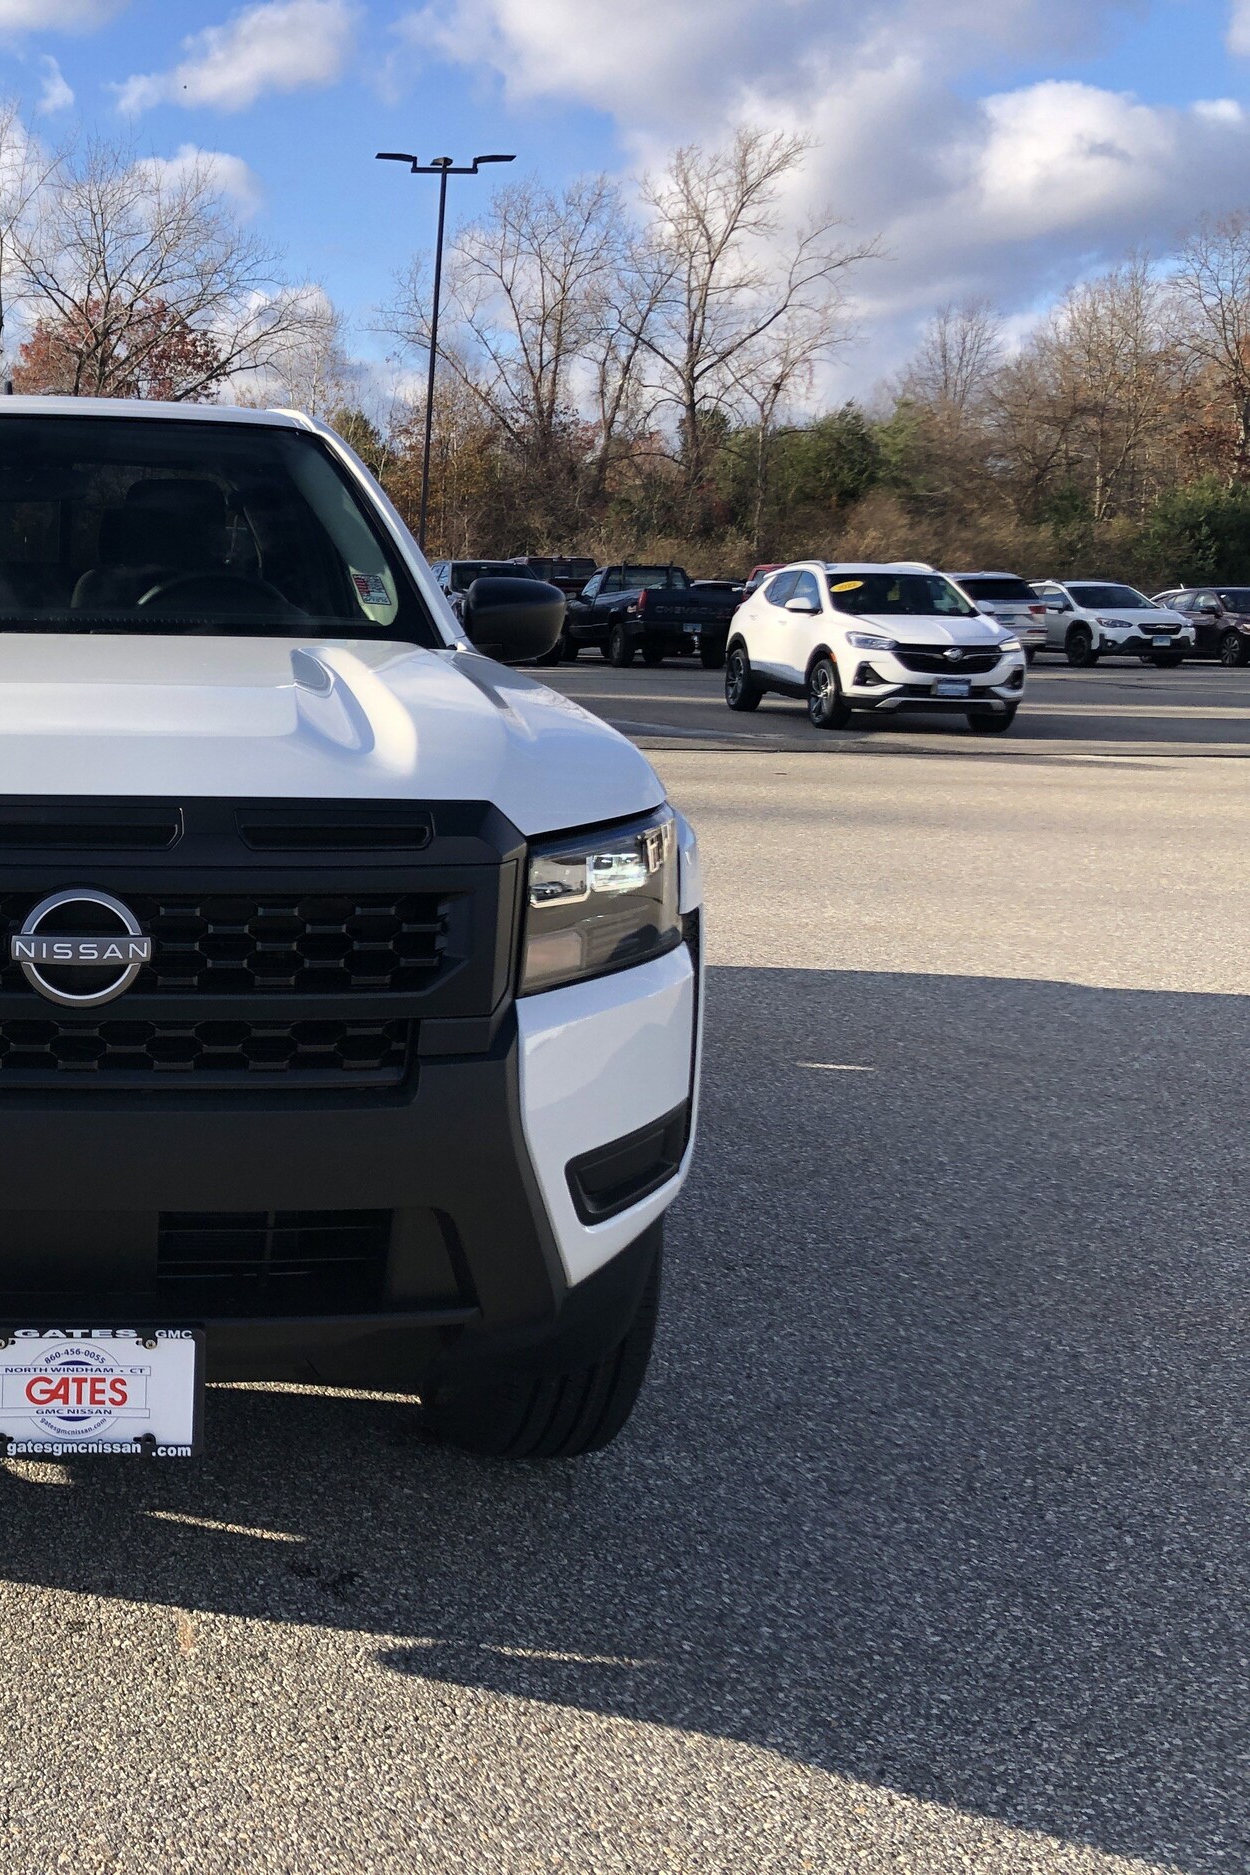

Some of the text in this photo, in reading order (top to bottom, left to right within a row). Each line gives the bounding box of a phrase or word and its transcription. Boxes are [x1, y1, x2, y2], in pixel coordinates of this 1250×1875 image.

[15, 941, 148, 960] NISSAN
[14, 1329, 138, 1338] GATES
[155, 1330, 192, 1339] GMC
[44, 1348, 106, 1364] 860-456-0055
[25, 1376, 128, 1406] GATES
[40, 1417, 107, 1436] gatesgmcnissan.com
